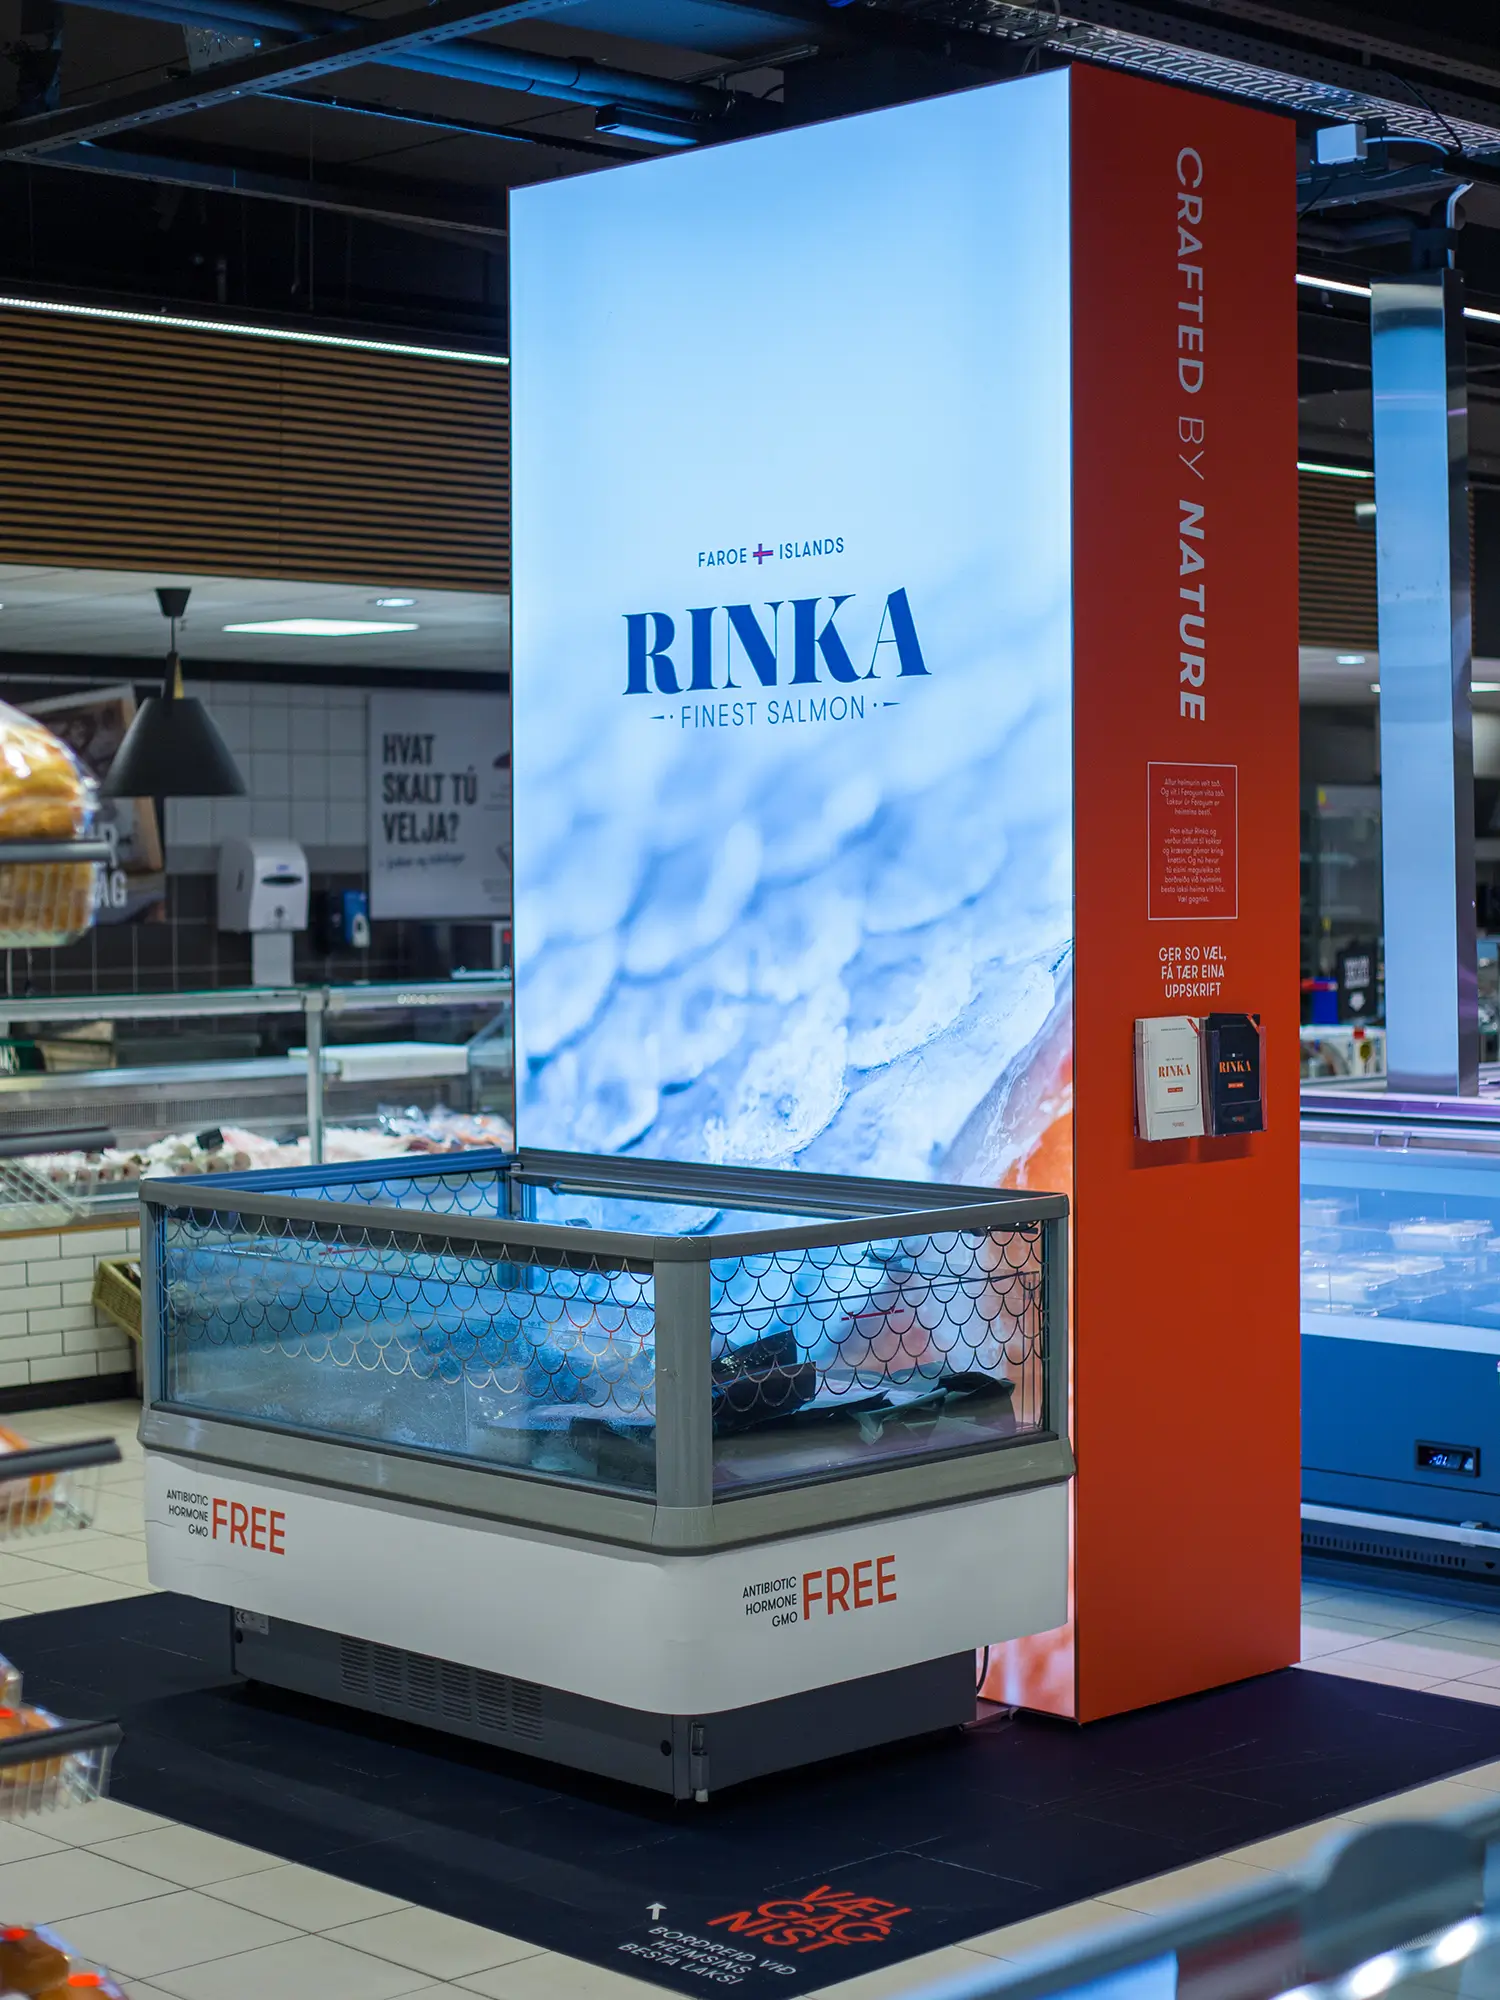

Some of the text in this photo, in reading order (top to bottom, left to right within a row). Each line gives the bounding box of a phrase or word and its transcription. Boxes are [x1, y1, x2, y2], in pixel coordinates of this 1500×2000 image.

[1176, 147, 1205, 721] CRAFTED BY NATURE
[698, 536, 845, 568] FAROE ISLANDS
[622, 587, 932, 696] RINKA
[681, 695, 865, 729] FINEST SALMON
[382, 733, 435, 766] HVAT
[382, 772, 443, 805] SKALT
[452, 764, 479, 806] TÚ
[1160, 787, 1169, 797] Og
[382, 811, 460, 844] VELJA?
[1194, 827, 1209, 835] Rinka
[1188, 856, 1196, 866] Og
[1159, 946, 1227, 962] GER SO VÆL,
[1161, 962, 1225, 980] FÁ TÆR EINA
[1165, 982, 1222, 998] UPPSKRIFT
[1158, 1065, 1192, 1079] RINKA
[1219, 1060, 1252, 1074] RINKA
[166, 1489, 208, 1506] ANTIBIOTIC
[168, 1504, 208, 1522] HORMONE
[188, 1524, 208, 1538] GMO
[212, 1498, 286, 1556] FREE
[742, 1576, 797, 1599] ANTIBIOTIC
[803, 1554, 897, 1621] FREE
[746, 1594, 798, 1616] HORMONE
[772, 1611, 798, 1628] GMO
[802, 1885, 912, 1926] VÆL
[706, 1911, 850, 1954] NIST
[757, 1900, 891, 1943] GAG
[618, 1943, 744, 1985] BESTA LAKSI
[650, 1940, 752, 1974] HEIMSINS
[759, 1959, 797, 1975] VIÐ
